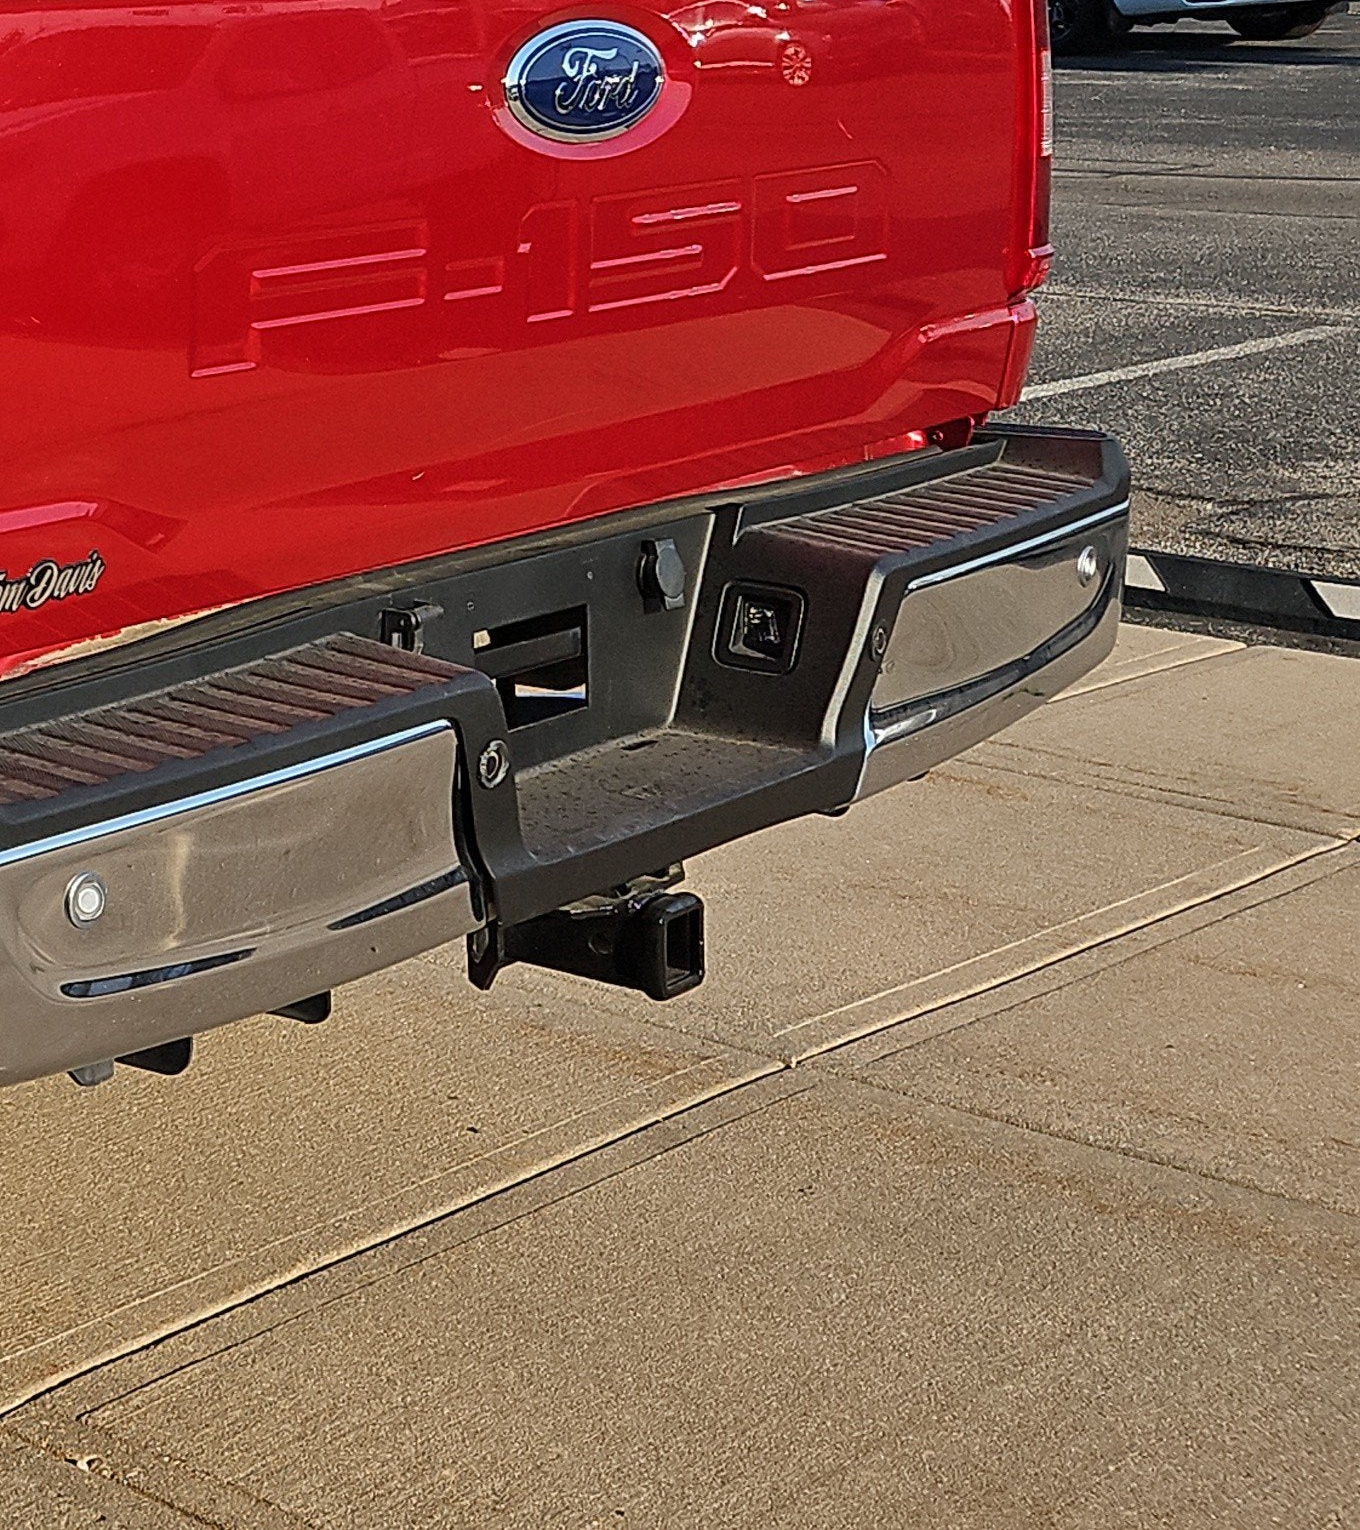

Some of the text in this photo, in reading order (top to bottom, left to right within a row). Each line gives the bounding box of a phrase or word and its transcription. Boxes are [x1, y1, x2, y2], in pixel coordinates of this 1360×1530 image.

[554, 46, 640, 115] Ford
[189, 158, 889, 378] F-150
[26, 550, 106, 609] Davis
